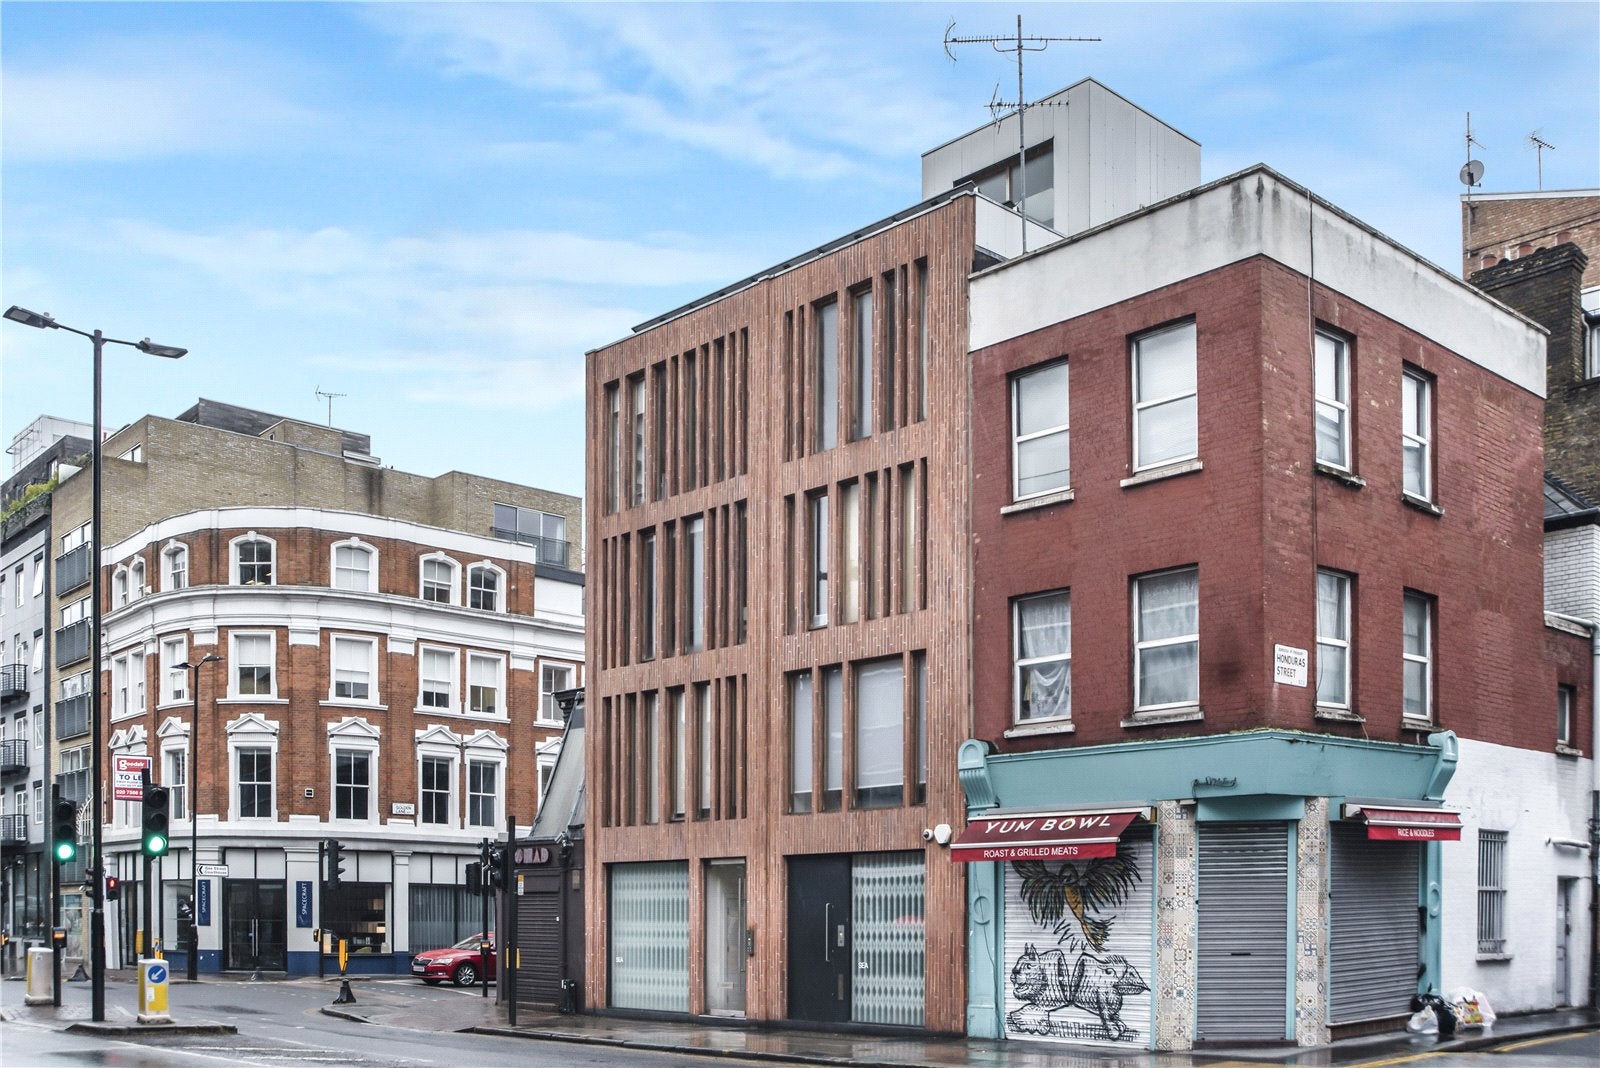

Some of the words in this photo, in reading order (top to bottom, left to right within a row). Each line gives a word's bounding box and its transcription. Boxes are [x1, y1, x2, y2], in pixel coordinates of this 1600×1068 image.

[1276, 653, 1305, 668] HONDURAS
[1276, 666, 1296, 678] STREET
[985, 819, 1036, 834] YUM
[1040, 815, 1111, 831] BOWL
[1397, 828, 1409, 836] RICE
[1409, 828, 1414, 837] &
[1413, 829, 1435, 837] NOODLES
[514, 847, 549, 864] OMAD
[983, 849, 1010, 858] ROAST
[1010, 848, 1016, 857] &
[1017, 847, 1050, 857] GRILLED
[1051, 846, 1079, 856] MEATS
[857, 961, 869, 969] SEA
